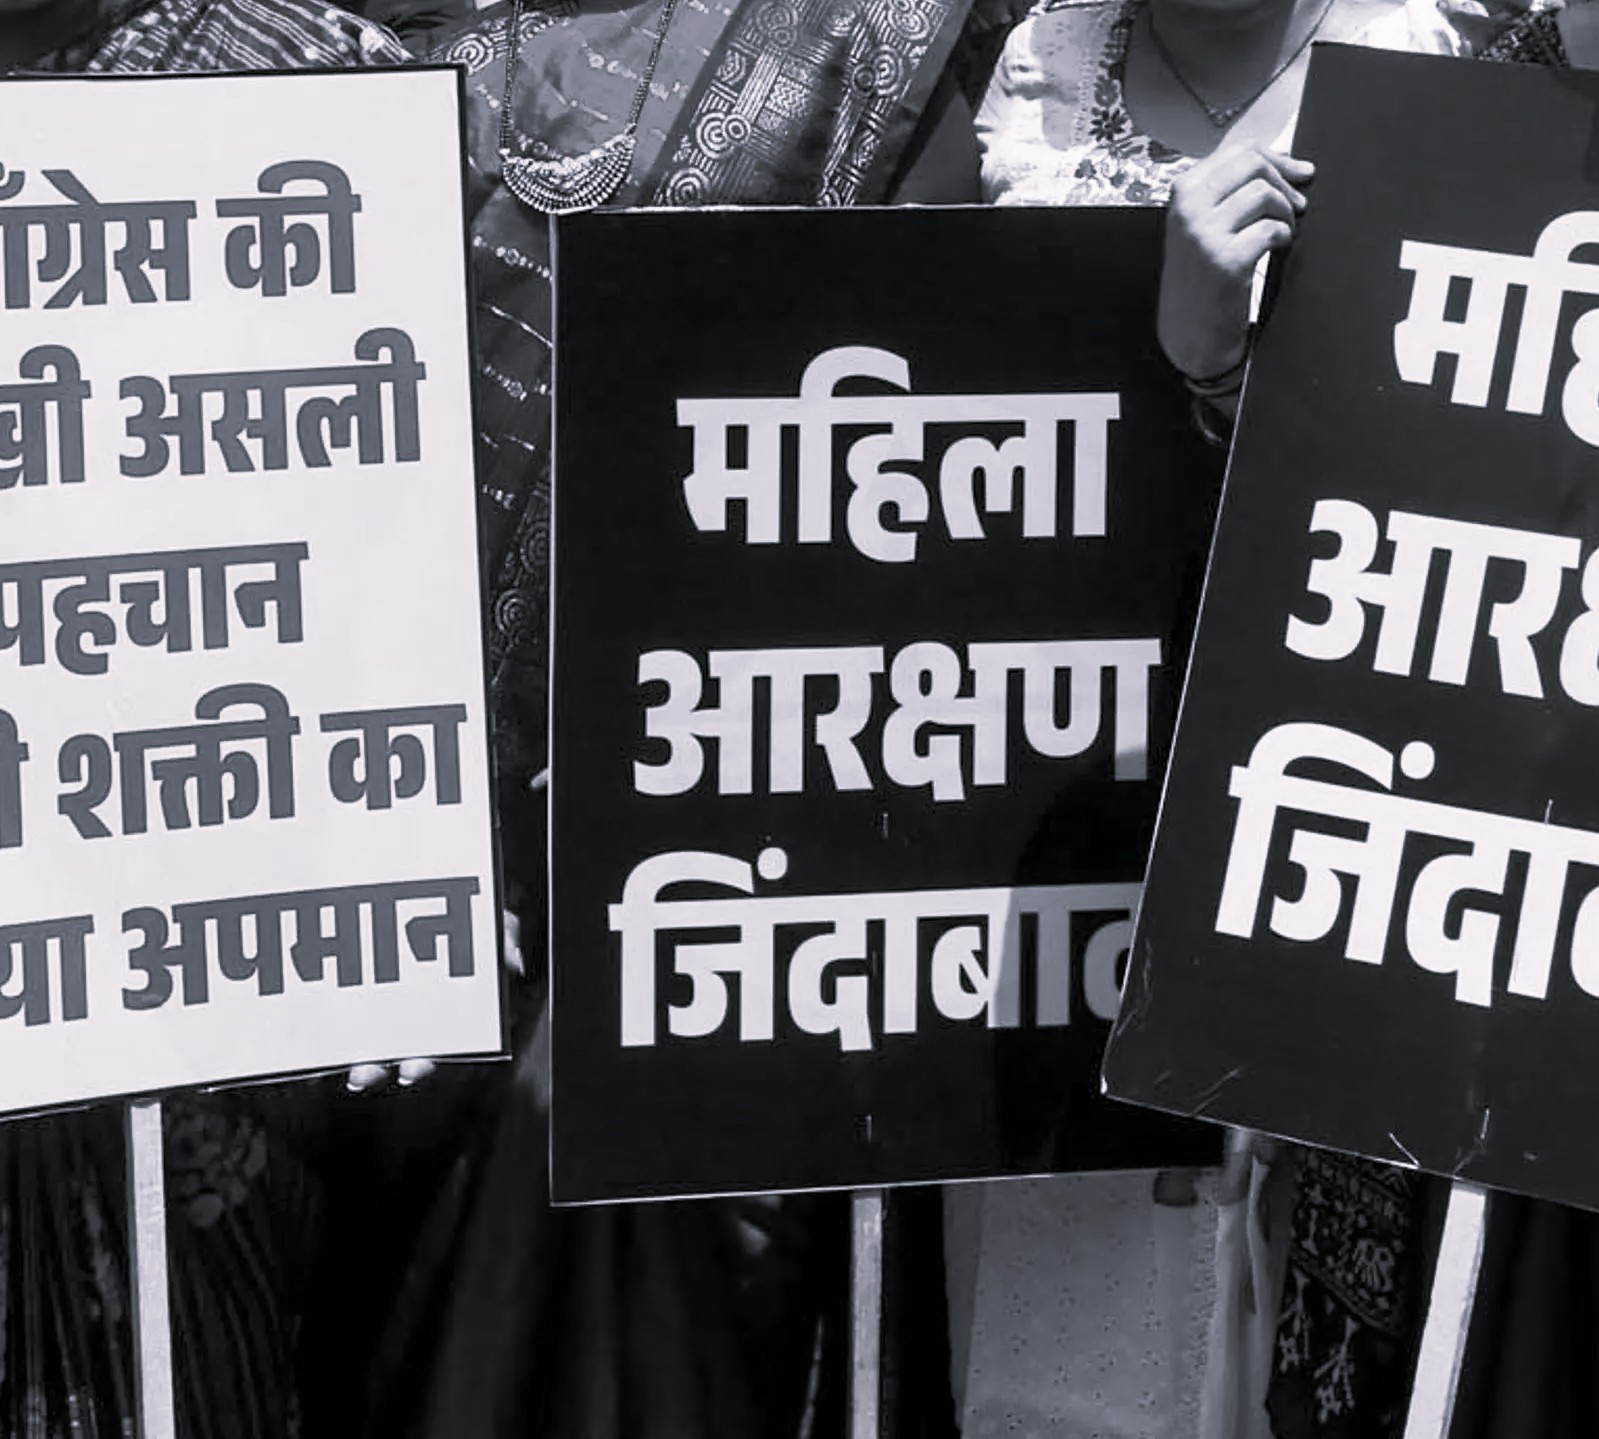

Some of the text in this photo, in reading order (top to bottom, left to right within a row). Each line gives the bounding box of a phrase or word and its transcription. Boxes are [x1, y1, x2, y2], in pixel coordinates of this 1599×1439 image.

[215, 160, 363, 297] की
[118, 327, 427, 478] असली
[676, 345, 1121, 564] महिला
[57, 683, 301, 840] शक्ती
[319, 703, 468, 812] का
[633, 638, 1162, 802] आरक्षण
[120, 875, 481, 1011] अपमान
